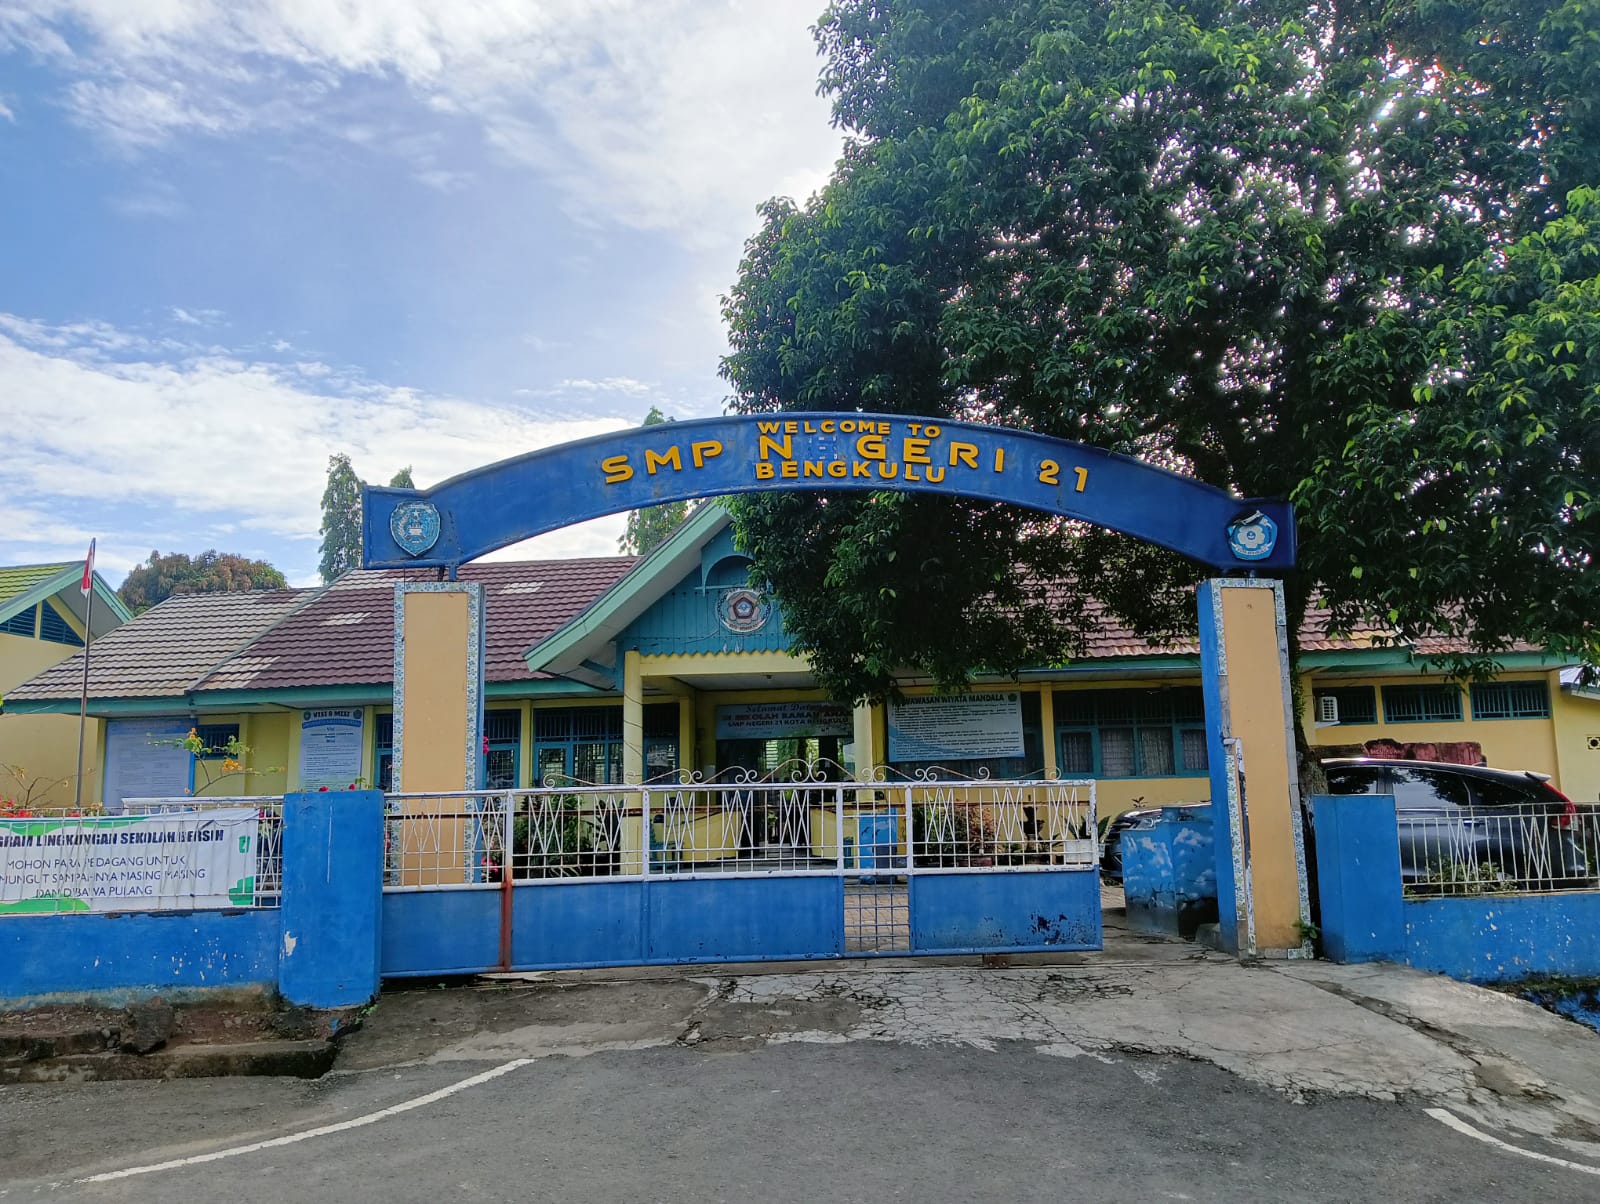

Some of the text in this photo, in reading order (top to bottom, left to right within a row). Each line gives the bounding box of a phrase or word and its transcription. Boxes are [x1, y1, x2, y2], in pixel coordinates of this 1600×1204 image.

[756, 419, 941, 439] WELCOME TO
[600, 440, 723, 484] SMP
[1037, 459, 1089, 493] 21
[755, 461, 946, 483] BENGKULU
[968, 694, 1004, 703] MANDALA
[36, 833, 117, 847] LINGKUNGAN
[120, 831, 176, 845] SEKOLAH
[178, 829, 224, 843] BERSIH
[8, 859, 51, 870] MOHON
[146, 855, 186, 866] UNTUK
[120, 870, 161, 881] MASING
[36, 888, 60, 898] DAN
[109, 885, 153, 897] PULANG
